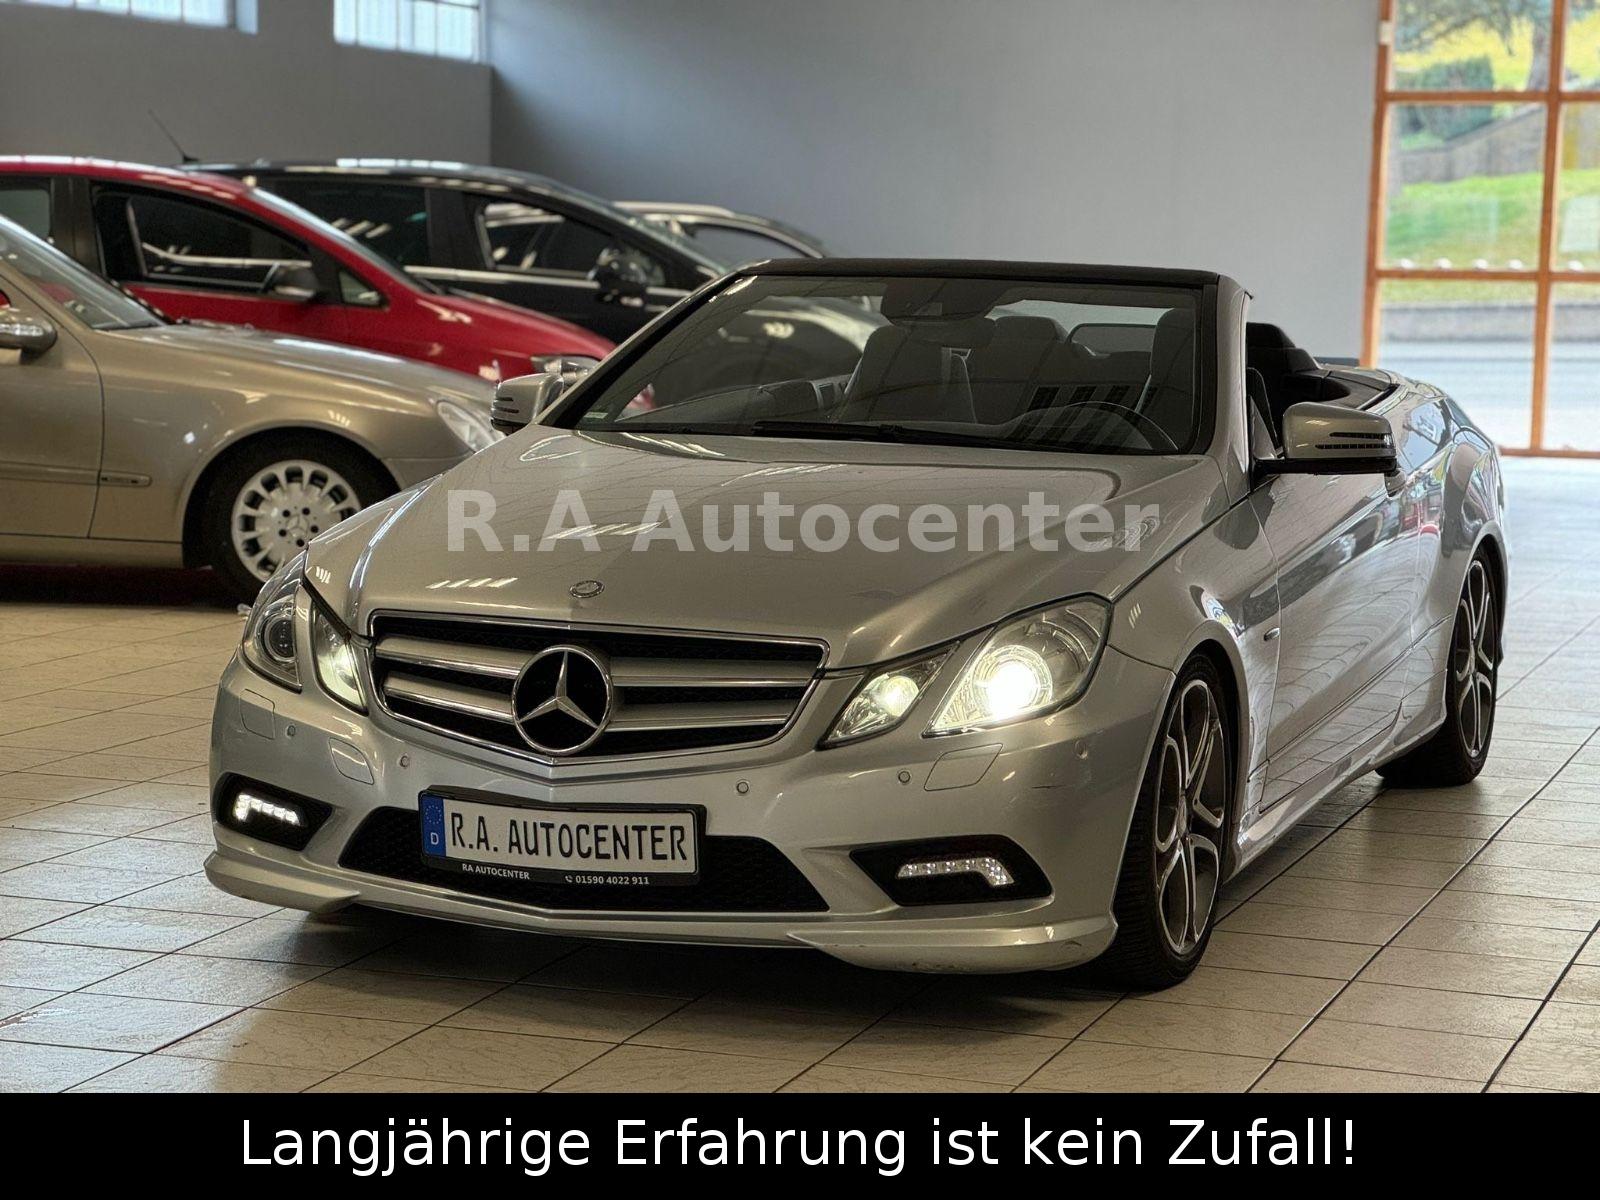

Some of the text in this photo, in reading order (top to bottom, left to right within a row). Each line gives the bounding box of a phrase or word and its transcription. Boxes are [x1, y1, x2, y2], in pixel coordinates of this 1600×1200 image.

[430, 832, 439, 845] D
[451, 812, 687, 861] R.A. AUTOCENTER
[462, 863, 530, 880] RA AUTOCENTER
[575, 875, 650, 885] 01590 4022 911
